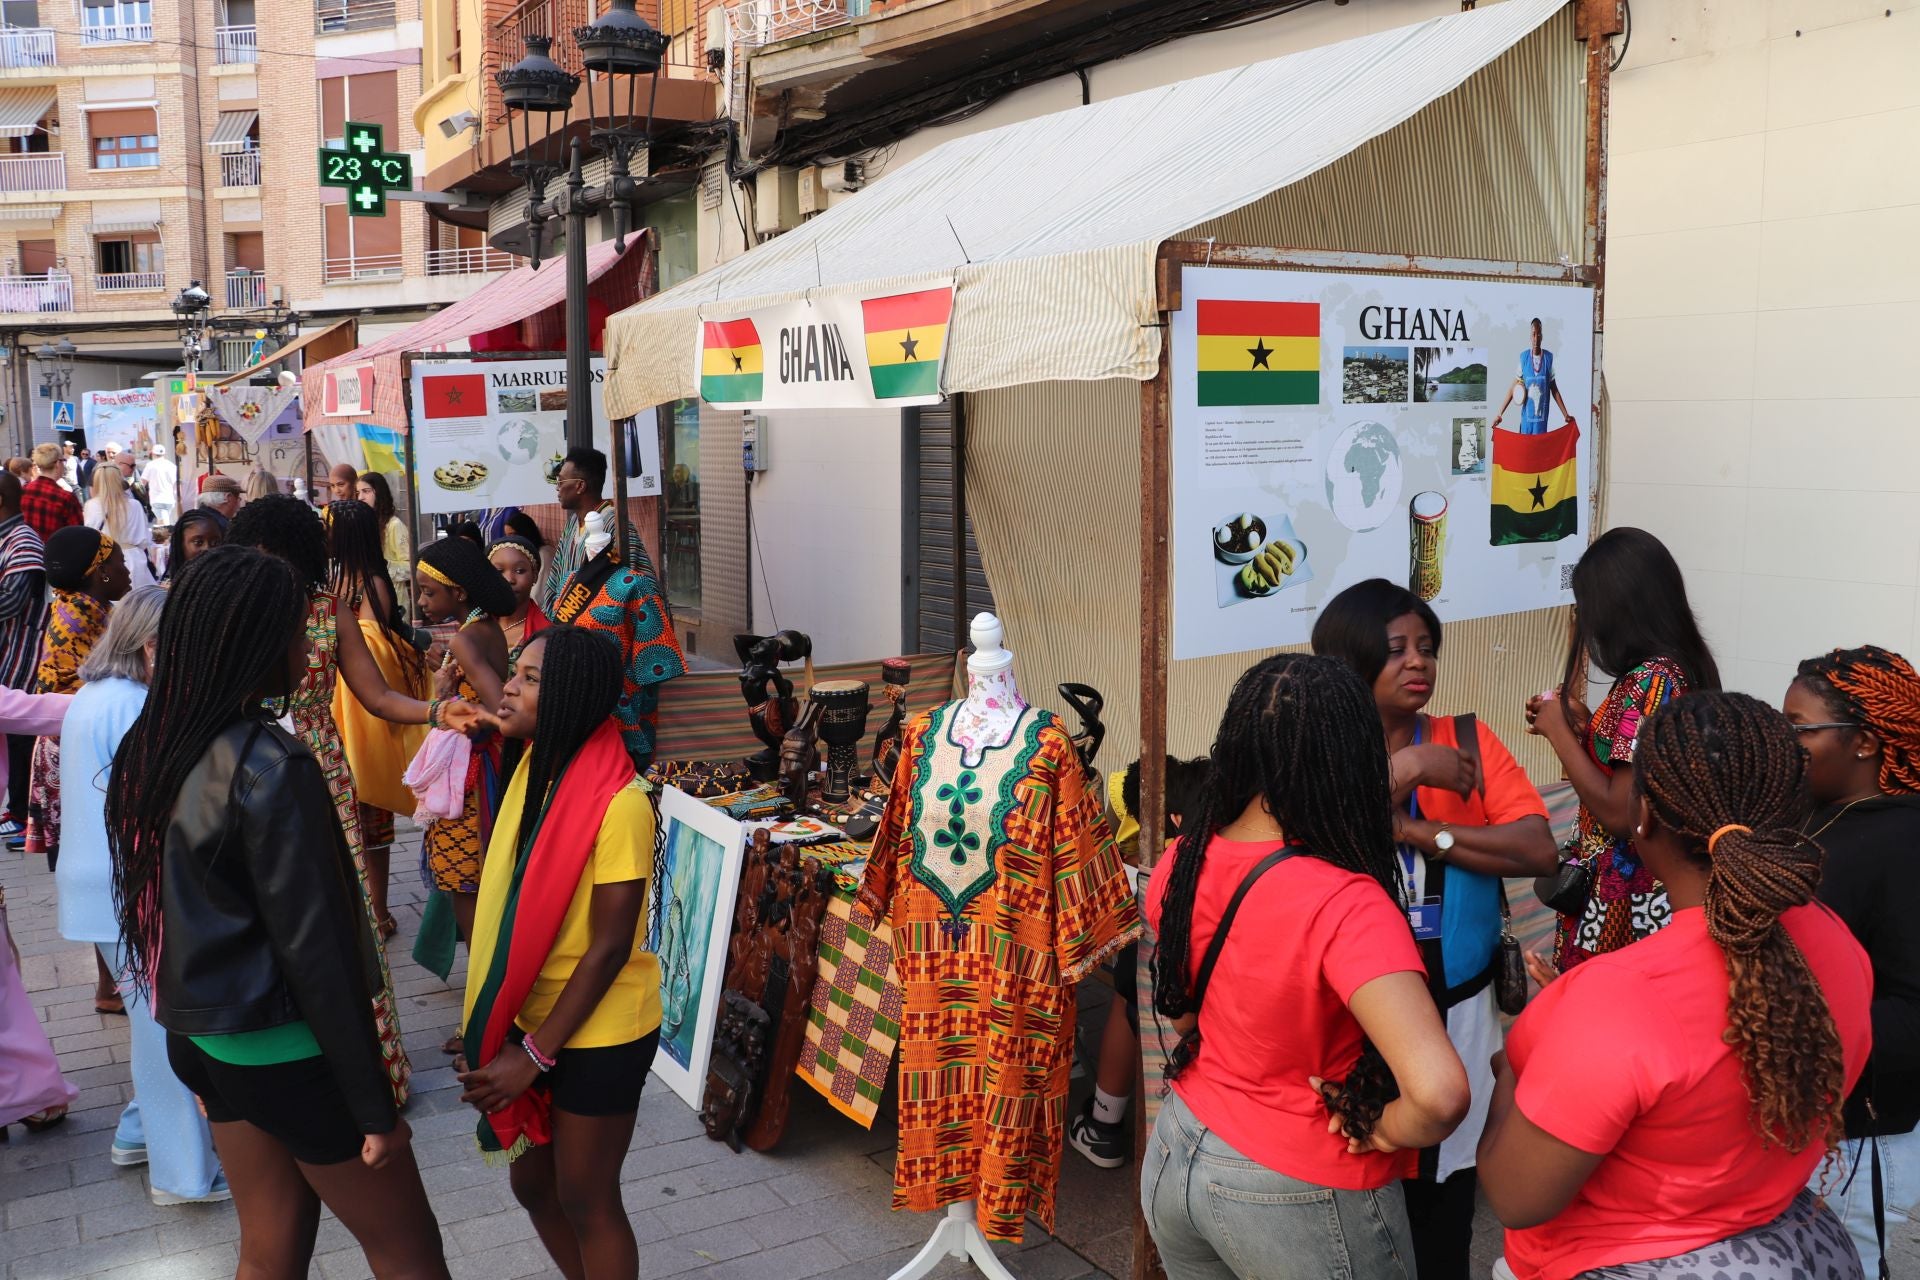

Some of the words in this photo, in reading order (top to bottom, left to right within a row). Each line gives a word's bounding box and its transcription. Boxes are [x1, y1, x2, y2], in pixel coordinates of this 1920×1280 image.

[328, 156, 361, 180] 23
[372, 159, 402, 183] °C
[1359, 305, 1470, 342] GHANA
[779, 323, 855, 385] GHANA
[492, 369, 604, 388] MARRUES
[556, 583, 592, 623] GHANA
